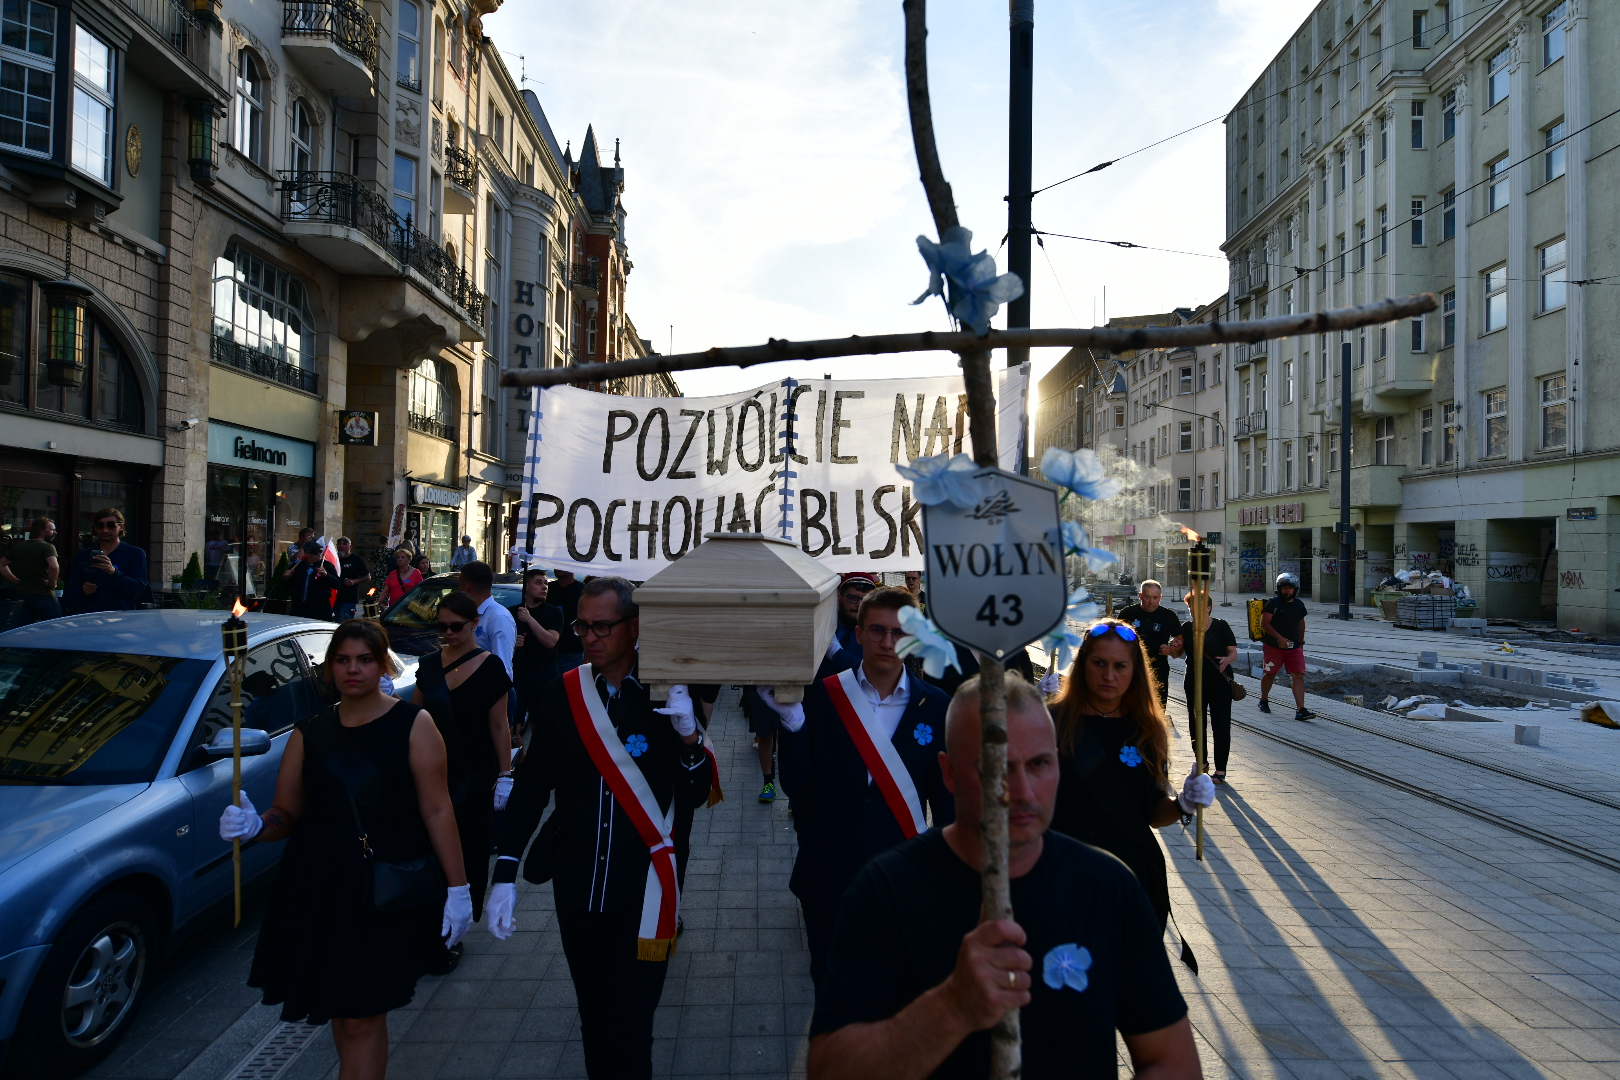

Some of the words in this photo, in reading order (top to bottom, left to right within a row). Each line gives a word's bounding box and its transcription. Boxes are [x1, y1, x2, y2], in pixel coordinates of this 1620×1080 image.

[1237, 505, 1269, 526] HOTEL
[1273, 502, 1305, 524] LECH
[932, 531, 1057, 578] WOŁYŃ
[975, 593, 1025, 628] 43
